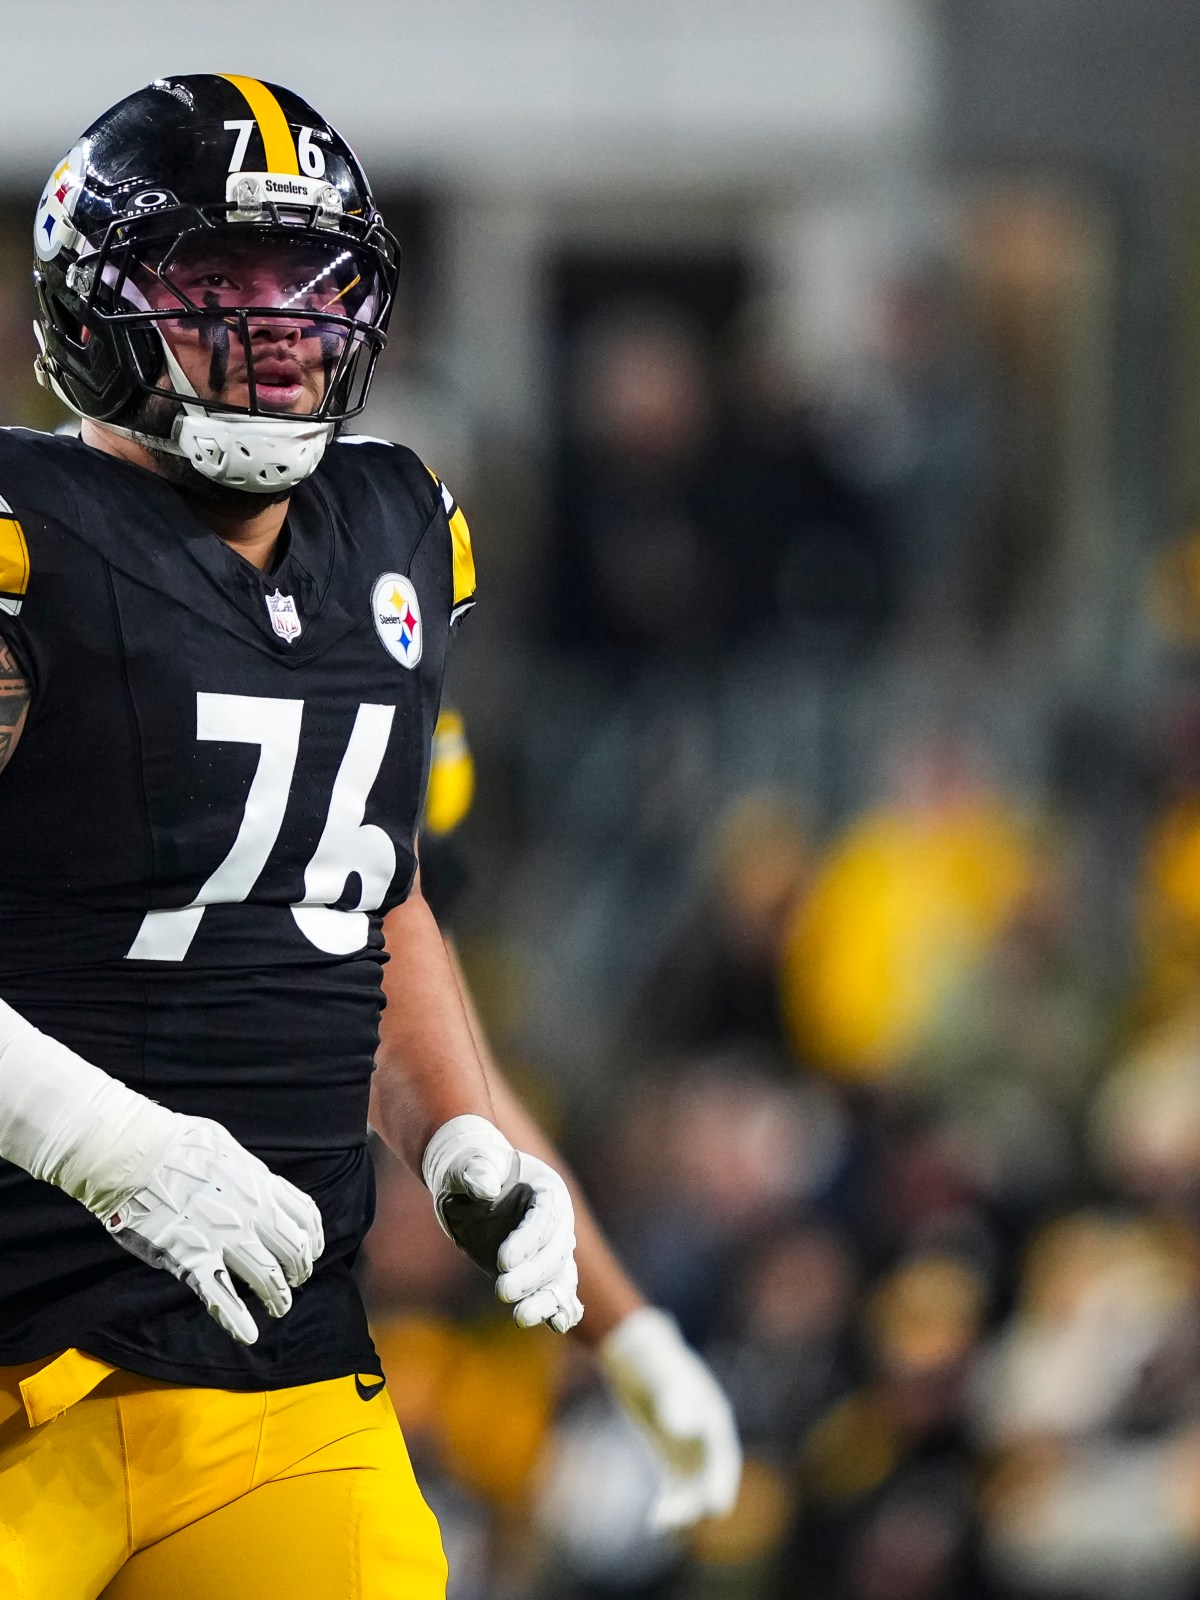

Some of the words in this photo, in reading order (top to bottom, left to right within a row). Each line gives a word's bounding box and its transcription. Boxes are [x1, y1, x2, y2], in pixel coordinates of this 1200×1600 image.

[223, 119, 326, 179] 76
[265, 180, 308, 196] Steelers
[274, 613, 298, 633] NFL
[379, 614, 401, 625] Steelers
[124, 692, 397, 962] 76
